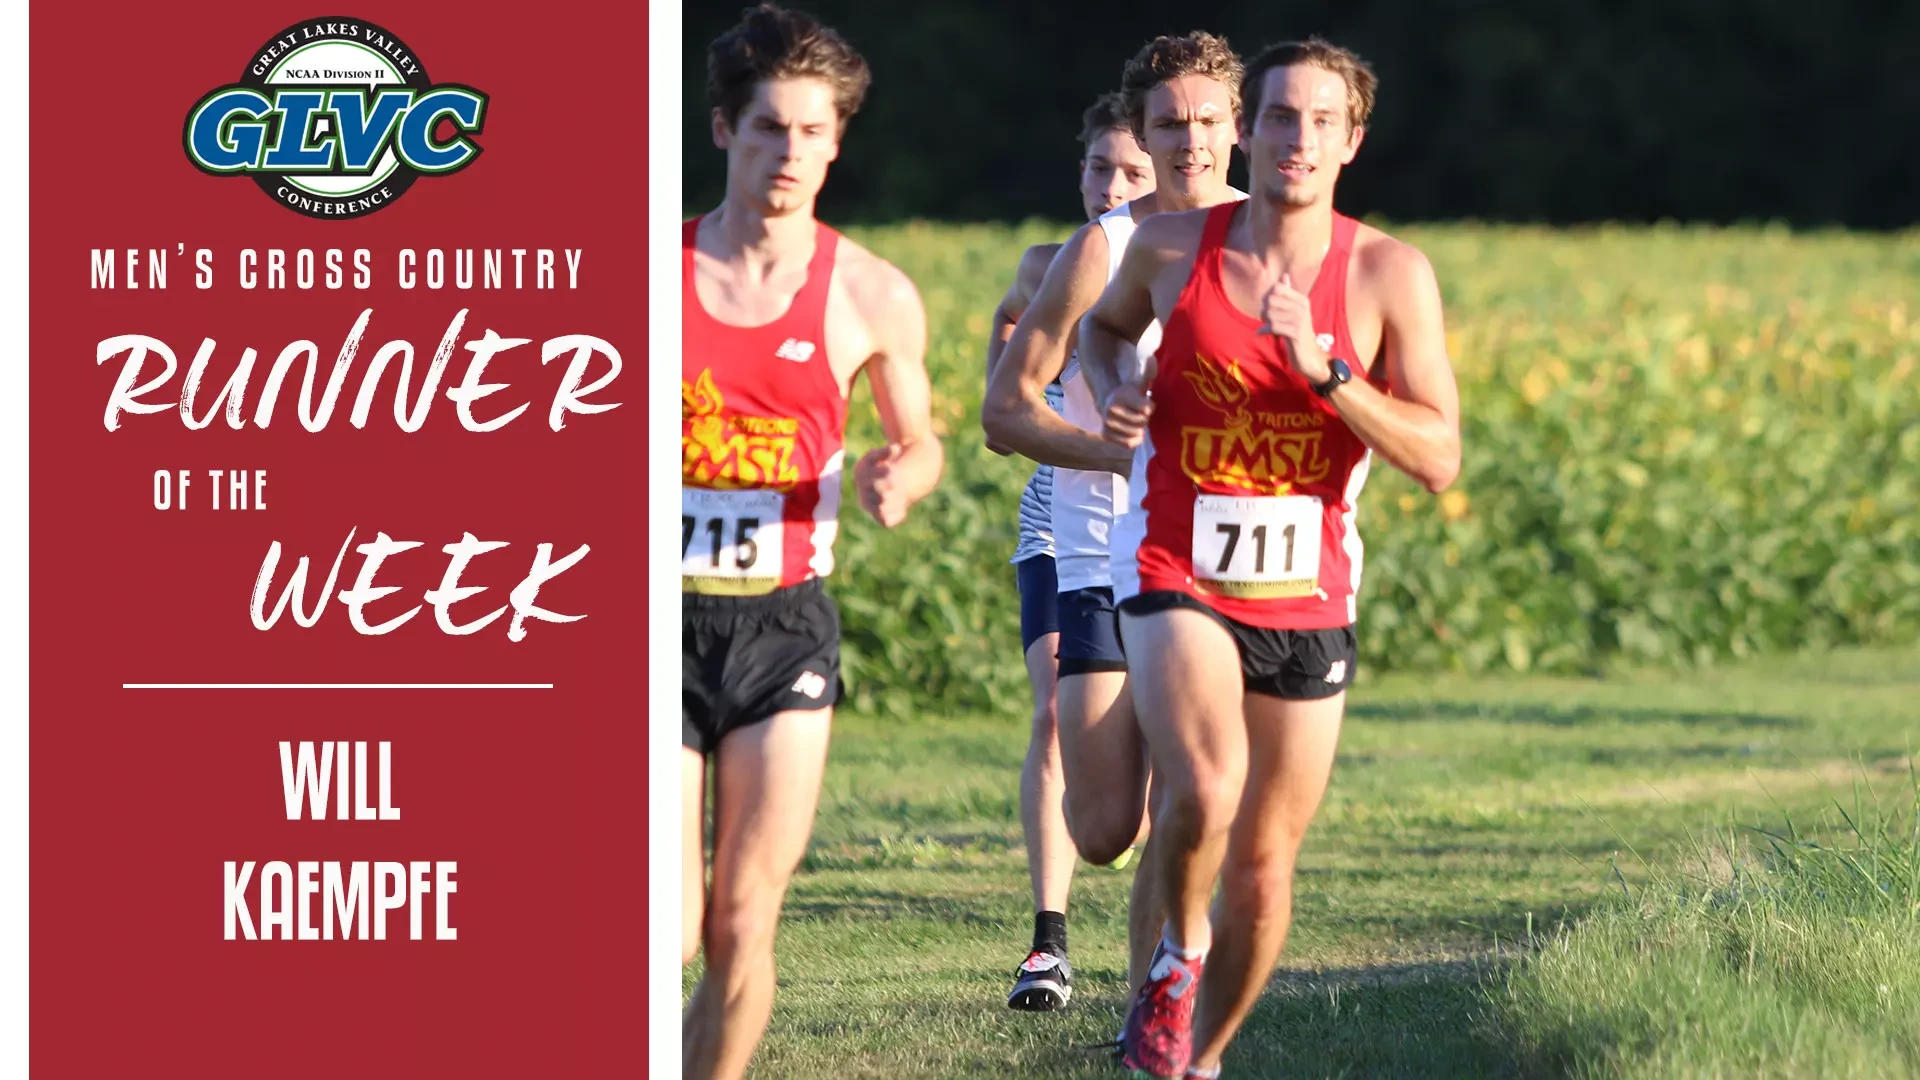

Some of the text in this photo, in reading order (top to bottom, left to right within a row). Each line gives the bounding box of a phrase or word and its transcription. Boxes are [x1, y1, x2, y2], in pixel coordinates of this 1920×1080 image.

[1256, 410, 1324, 430] TRITONS
[1181, 426, 1331, 494] UMSL
[1215, 522, 1297, 574] 711
